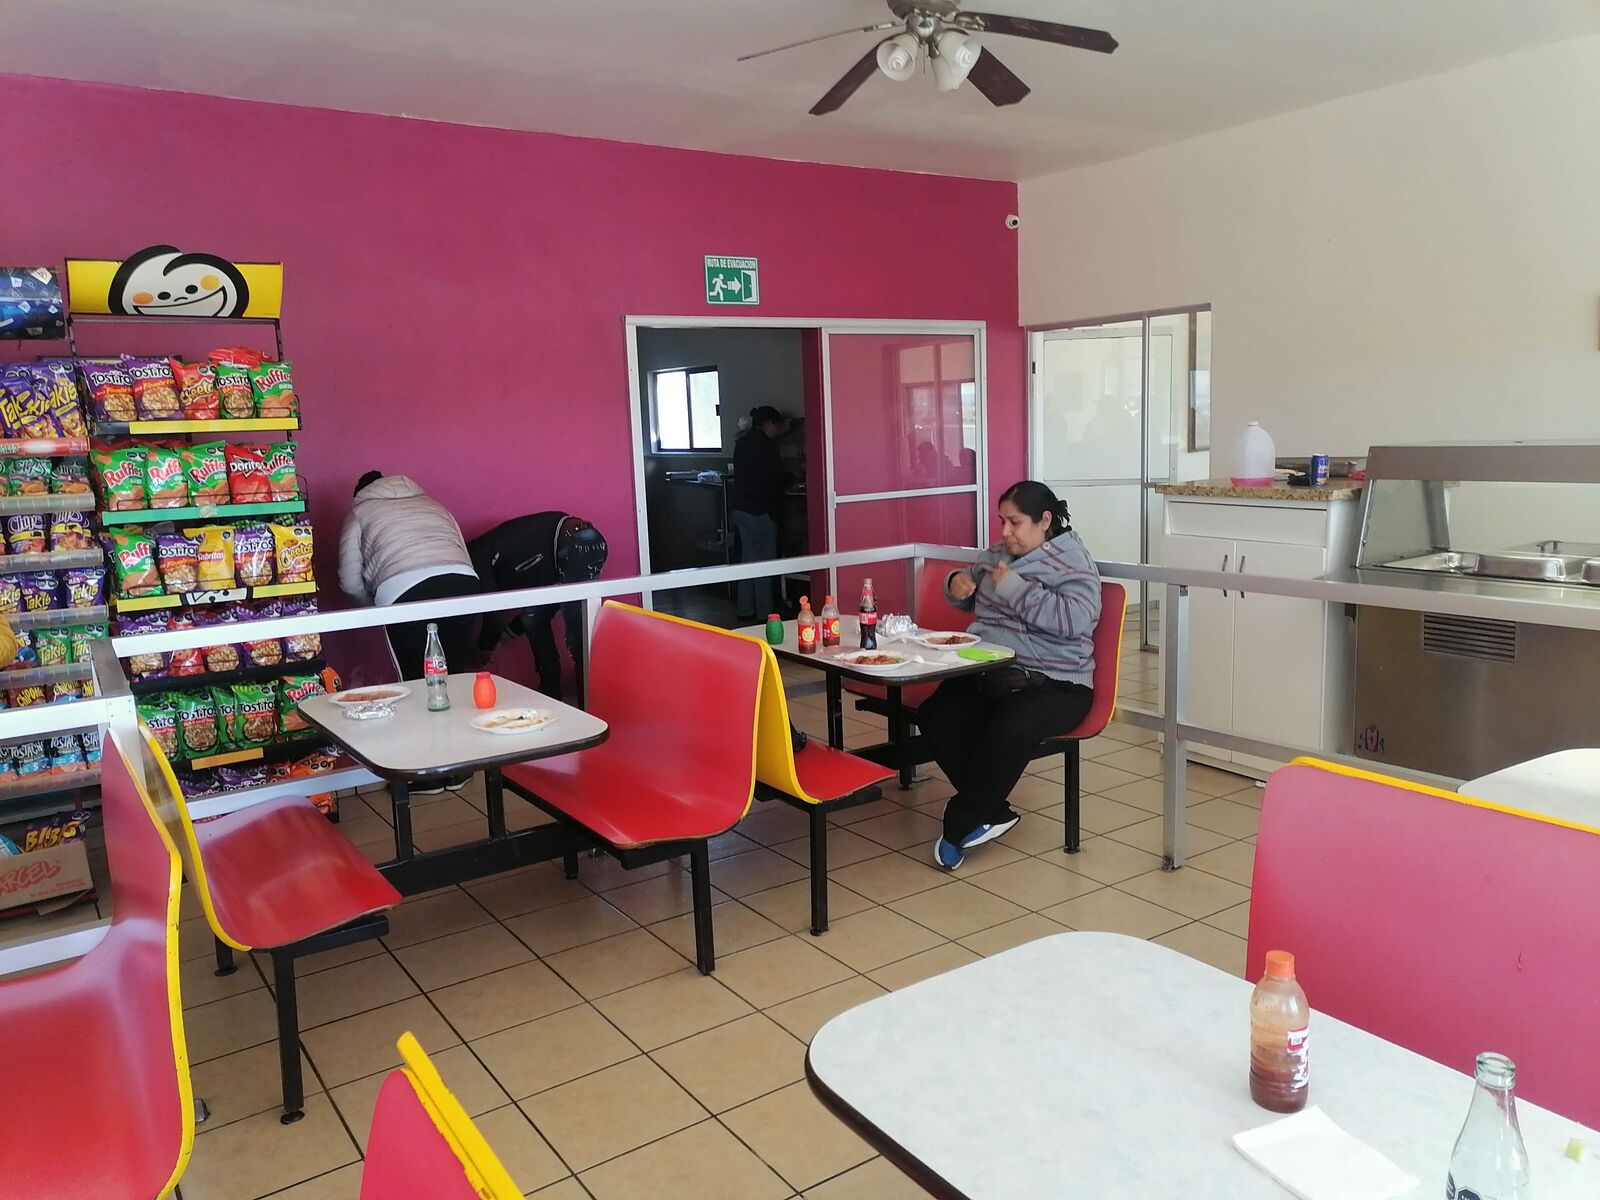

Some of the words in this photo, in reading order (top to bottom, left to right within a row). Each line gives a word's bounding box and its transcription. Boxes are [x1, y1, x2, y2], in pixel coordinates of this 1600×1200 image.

[720, 259, 727, 268] DE
[254, 368, 291, 393] Ruffle
[103, 462, 143, 488] Ruffles
[148, 459, 181, 482] Ruff
[189, 459, 227, 485] Ruffle
[118, 543, 151, 569] Ruff
[0, 588, 21, 605] akis
[24, 592, 51, 610] Takis
[71, 583, 99, 602] Takis
[39, 643, 67, 665] Takis
[72, 641, 90, 658] Tak
